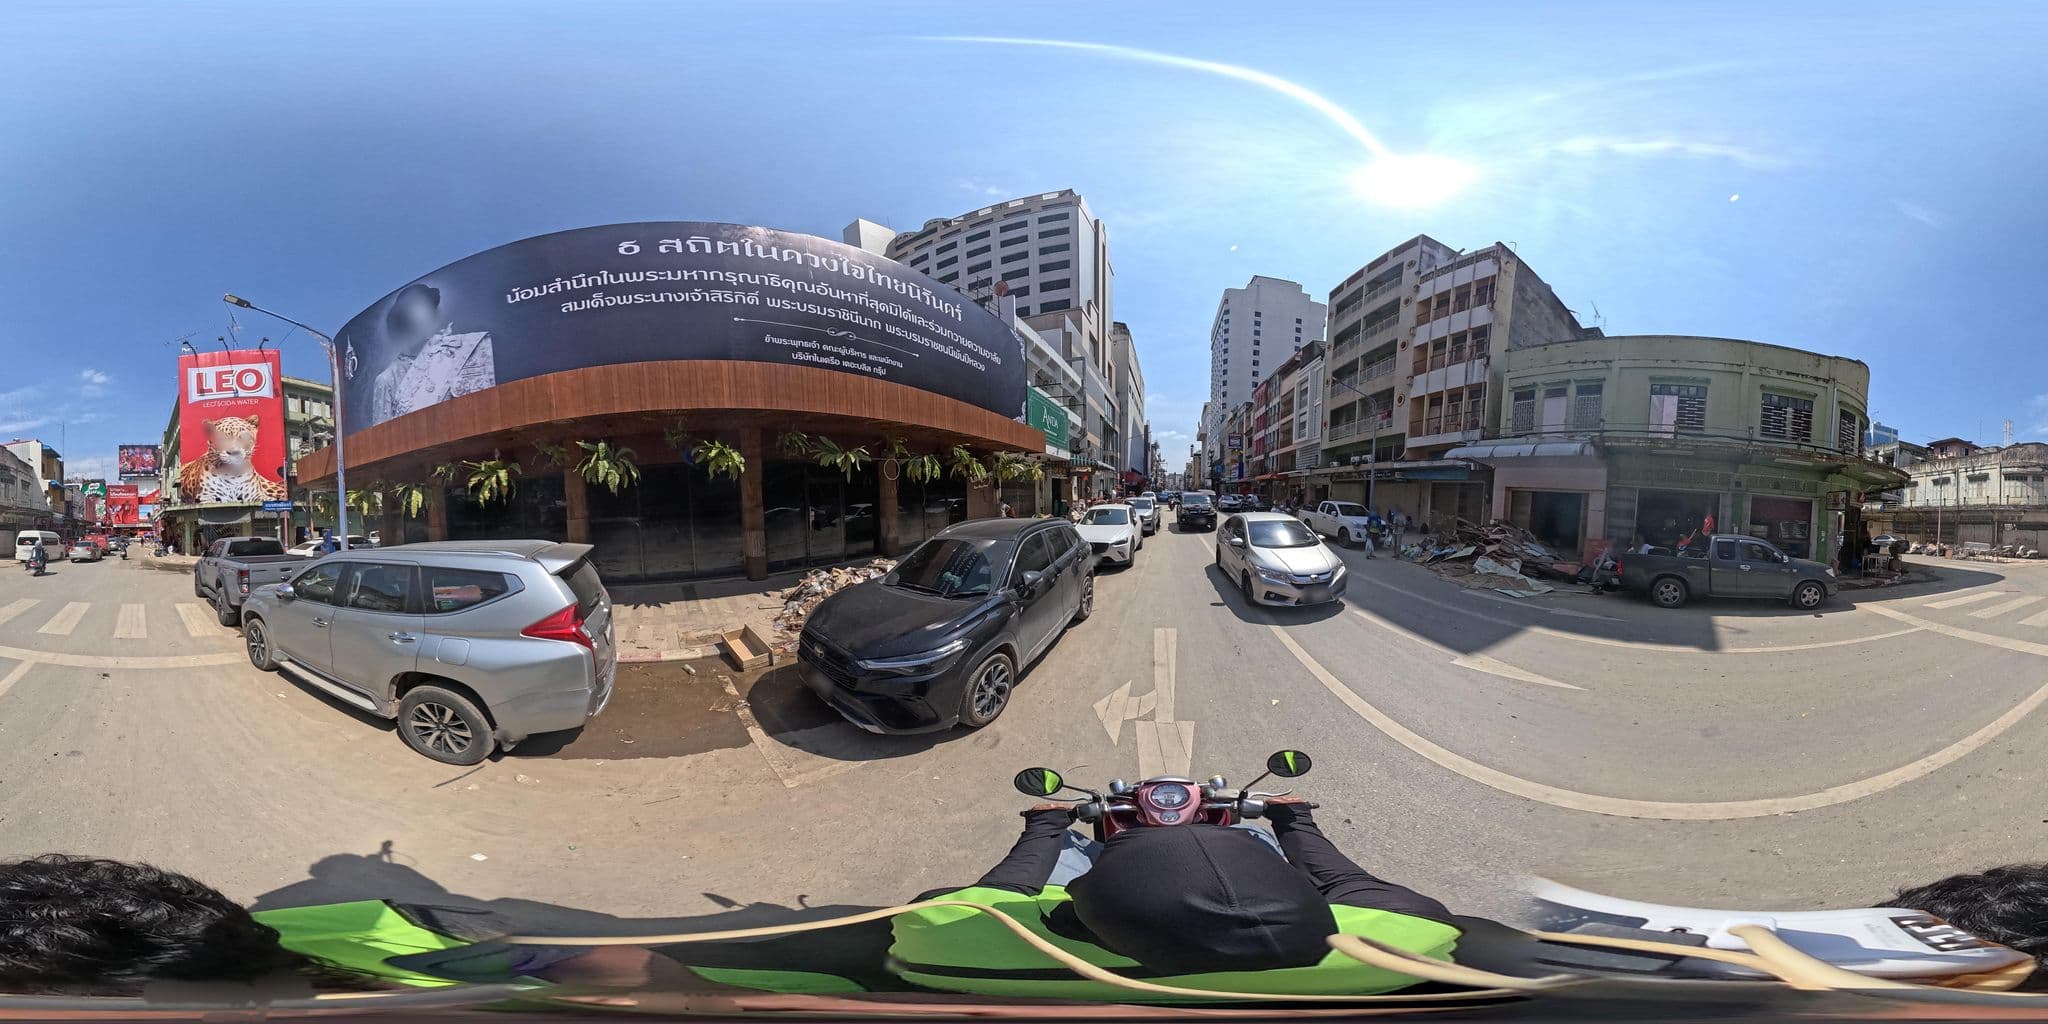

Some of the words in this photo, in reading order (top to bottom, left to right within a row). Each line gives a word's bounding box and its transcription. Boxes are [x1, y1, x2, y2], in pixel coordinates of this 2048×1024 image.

[617, 239, 641, 256] ธ
[658, 235, 963, 322] สถิตในดวงใจไทยนิรันดร์
[560, 288, 760, 313] สมเด็จพระนางเจ้าสิริกิติ์
[766, 297, 882, 330] พระบรมราชินีนาถ
[885, 324, 986, 373] พระบรมราชชนนีพันปีหลวง
[764, 334, 820, 350] ข้าพระพุทธเจ้า
[822, 343, 867, 359] คณะผู้บริหาร
[791, 352, 840, 366] บริษัทในเครือ
[195, 368, 265, 396] LEO
[237, 398, 259, 406] WATER
